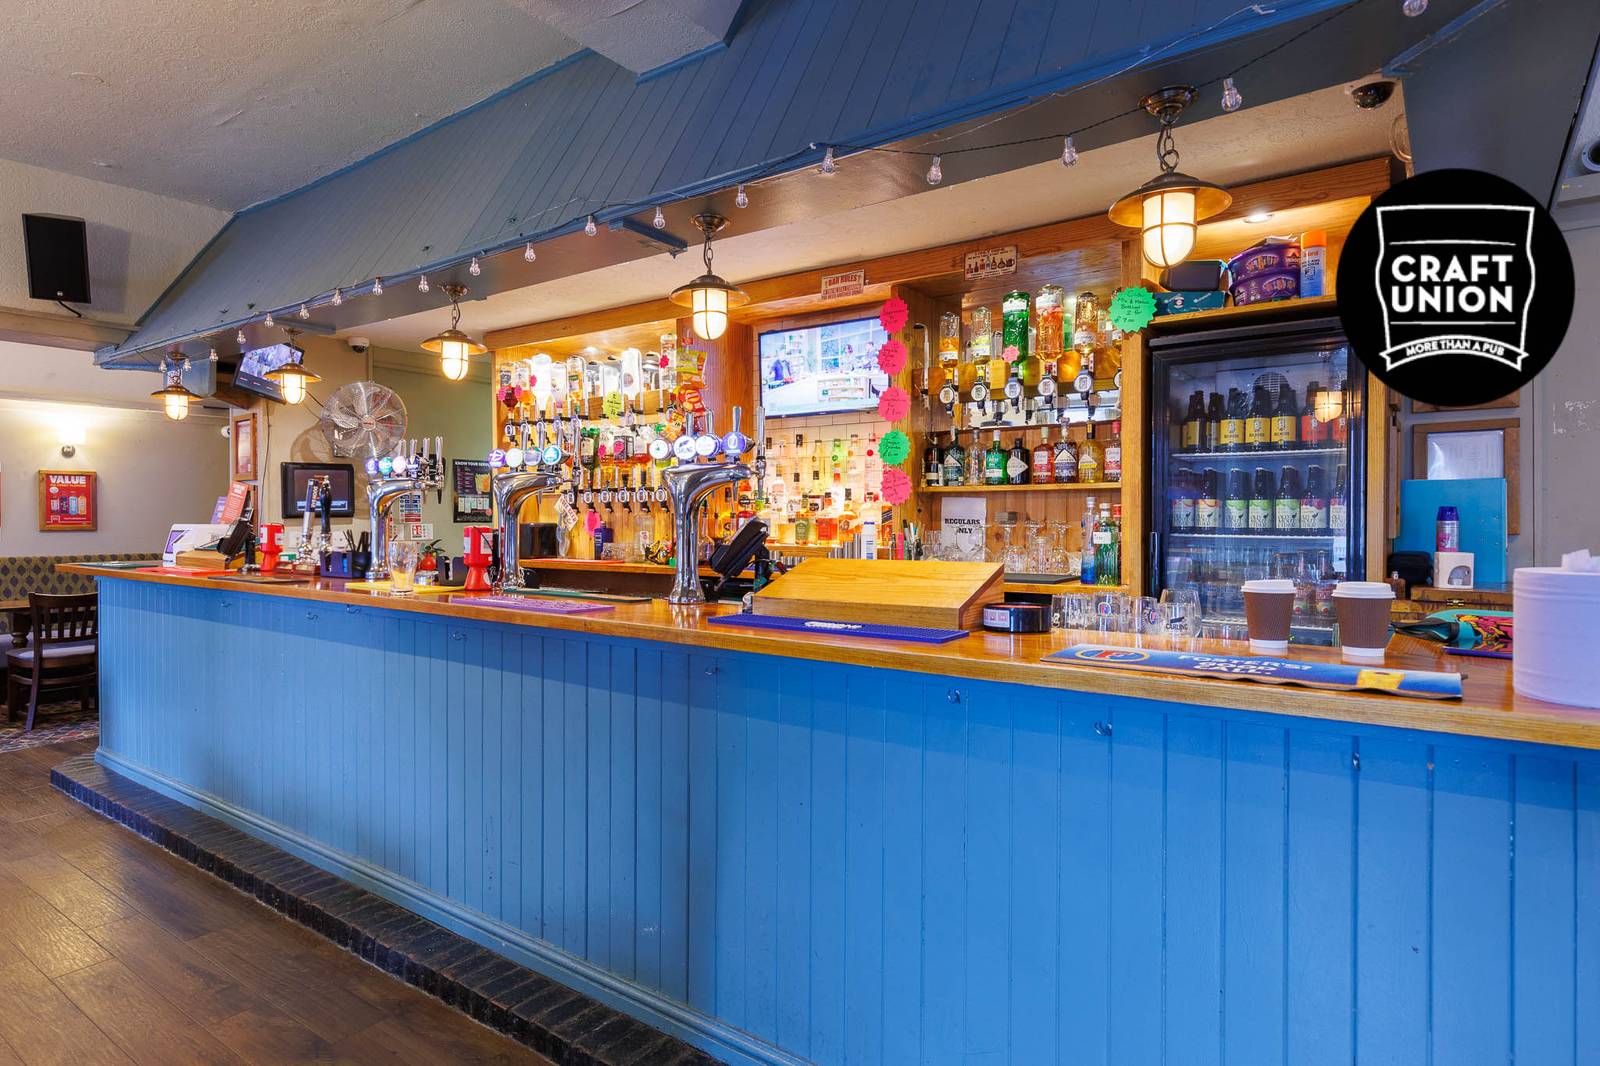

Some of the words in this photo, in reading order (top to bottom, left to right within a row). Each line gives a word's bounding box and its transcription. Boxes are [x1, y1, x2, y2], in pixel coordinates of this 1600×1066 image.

[840, 274, 858, 284] RULES
[49, 475, 87, 485] VALUE
[1198, 661, 1278, 671] GOOD
